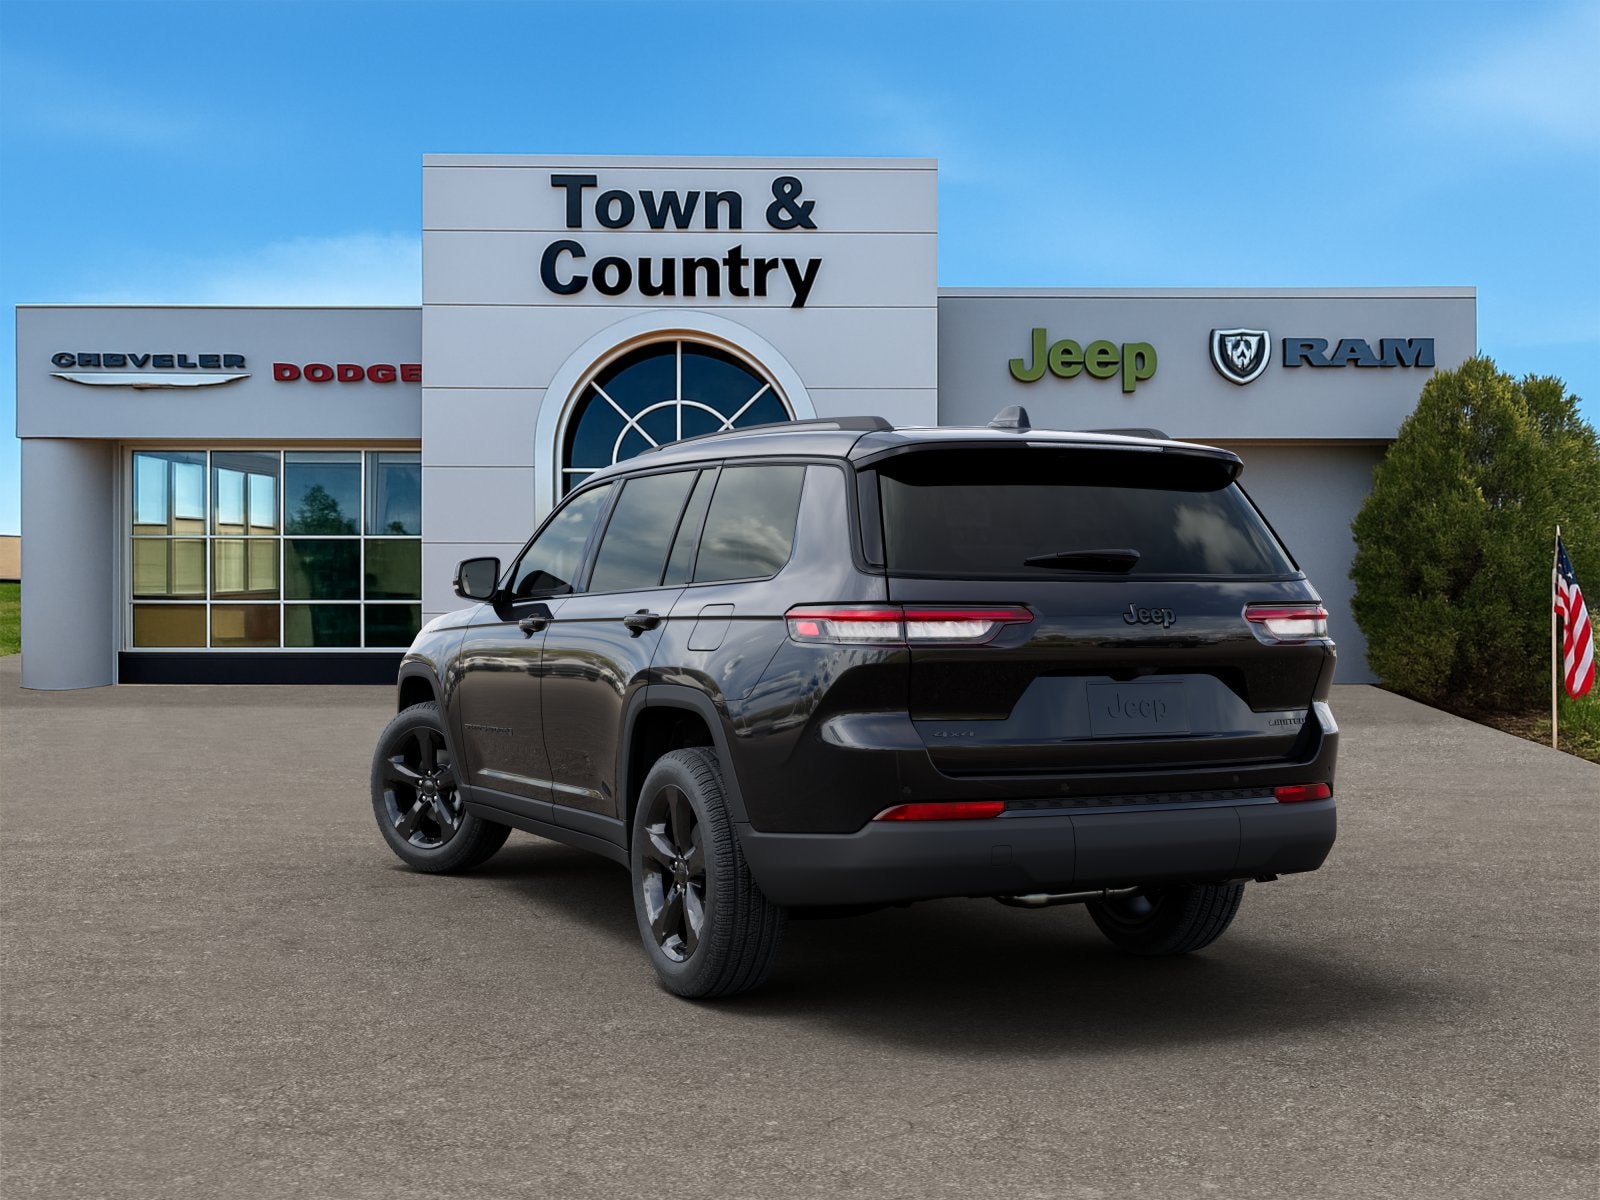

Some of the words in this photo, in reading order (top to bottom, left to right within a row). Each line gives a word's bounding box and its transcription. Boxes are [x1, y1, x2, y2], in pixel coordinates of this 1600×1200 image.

[550, 174, 743, 230] Town
[766, 175, 818, 230] &
[540, 239, 822, 308] Country
[1009, 327, 1157, 393] Jeep
[1282, 337, 1436, 368] RAM
[272, 362, 422, 382] DODGE
[1122, 602, 1177, 629] Jeep
[1105, 690, 1167, 723] Jeep
